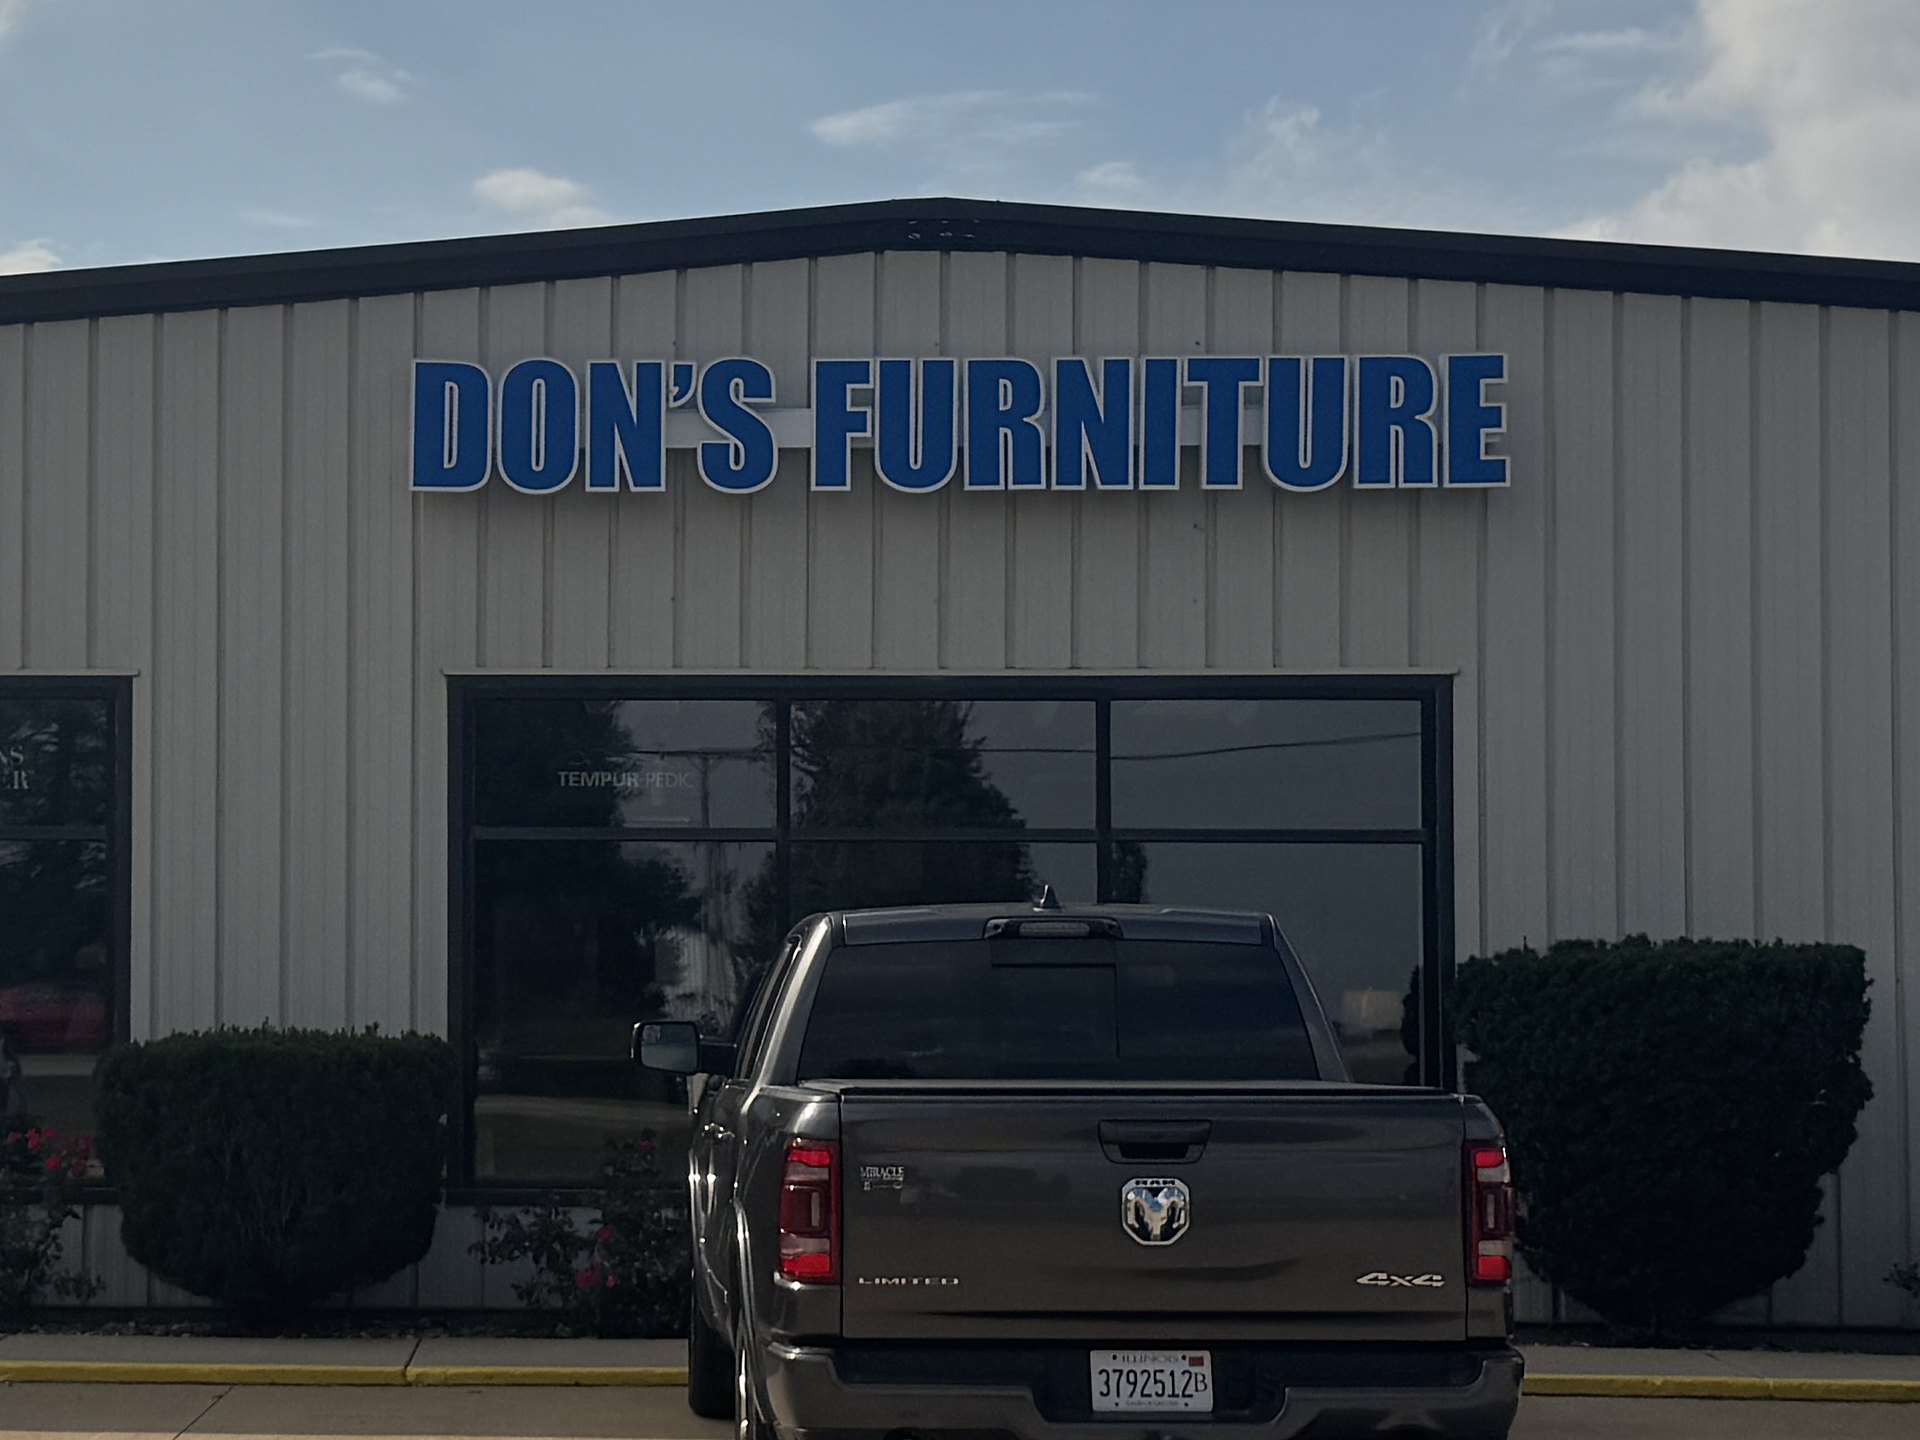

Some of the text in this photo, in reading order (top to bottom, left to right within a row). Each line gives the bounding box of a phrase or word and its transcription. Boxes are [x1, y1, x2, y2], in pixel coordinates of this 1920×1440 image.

[410, 352, 1512, 495] DON'S FURNITURE
[858, 1276, 960, 1286] LIMITED
